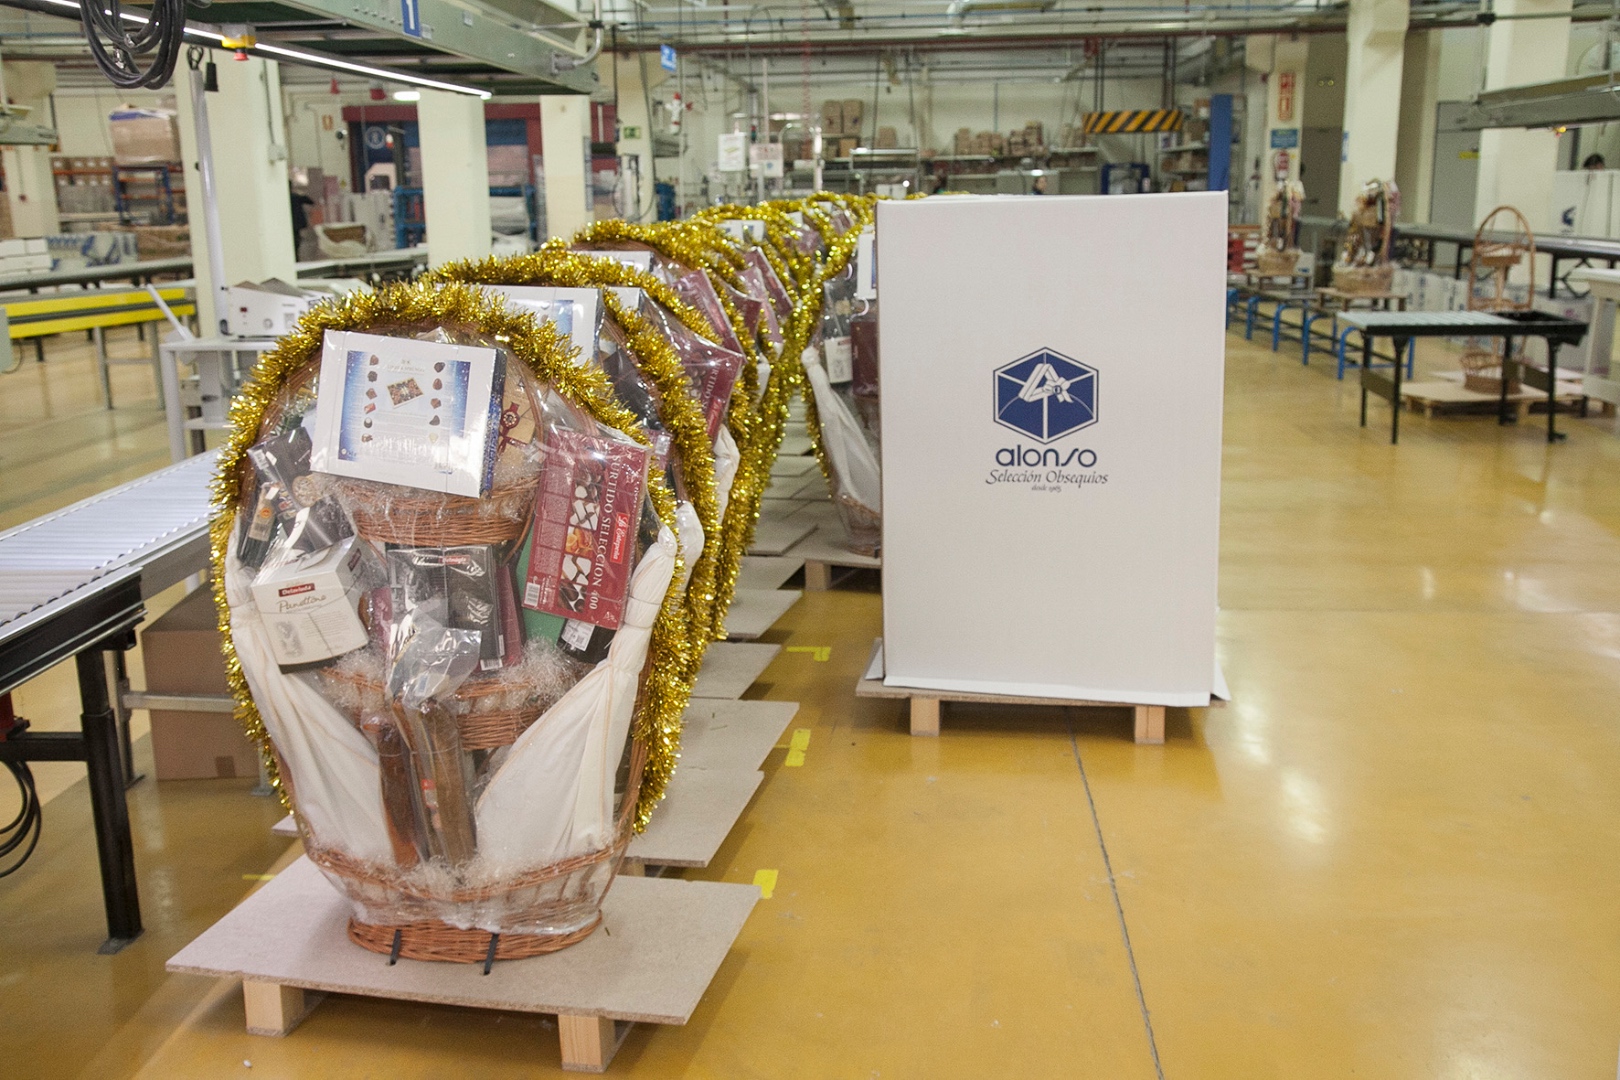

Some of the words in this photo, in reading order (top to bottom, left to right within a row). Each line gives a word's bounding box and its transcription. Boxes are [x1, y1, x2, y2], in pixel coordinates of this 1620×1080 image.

[995, 444, 1097, 468] alonso
[604, 455, 621, 514] SURTIDO
[986, 469, 1042, 485] Selección
[1045, 470, 1109, 489] Obsequios
[592, 517, 611, 586] SELECCION
